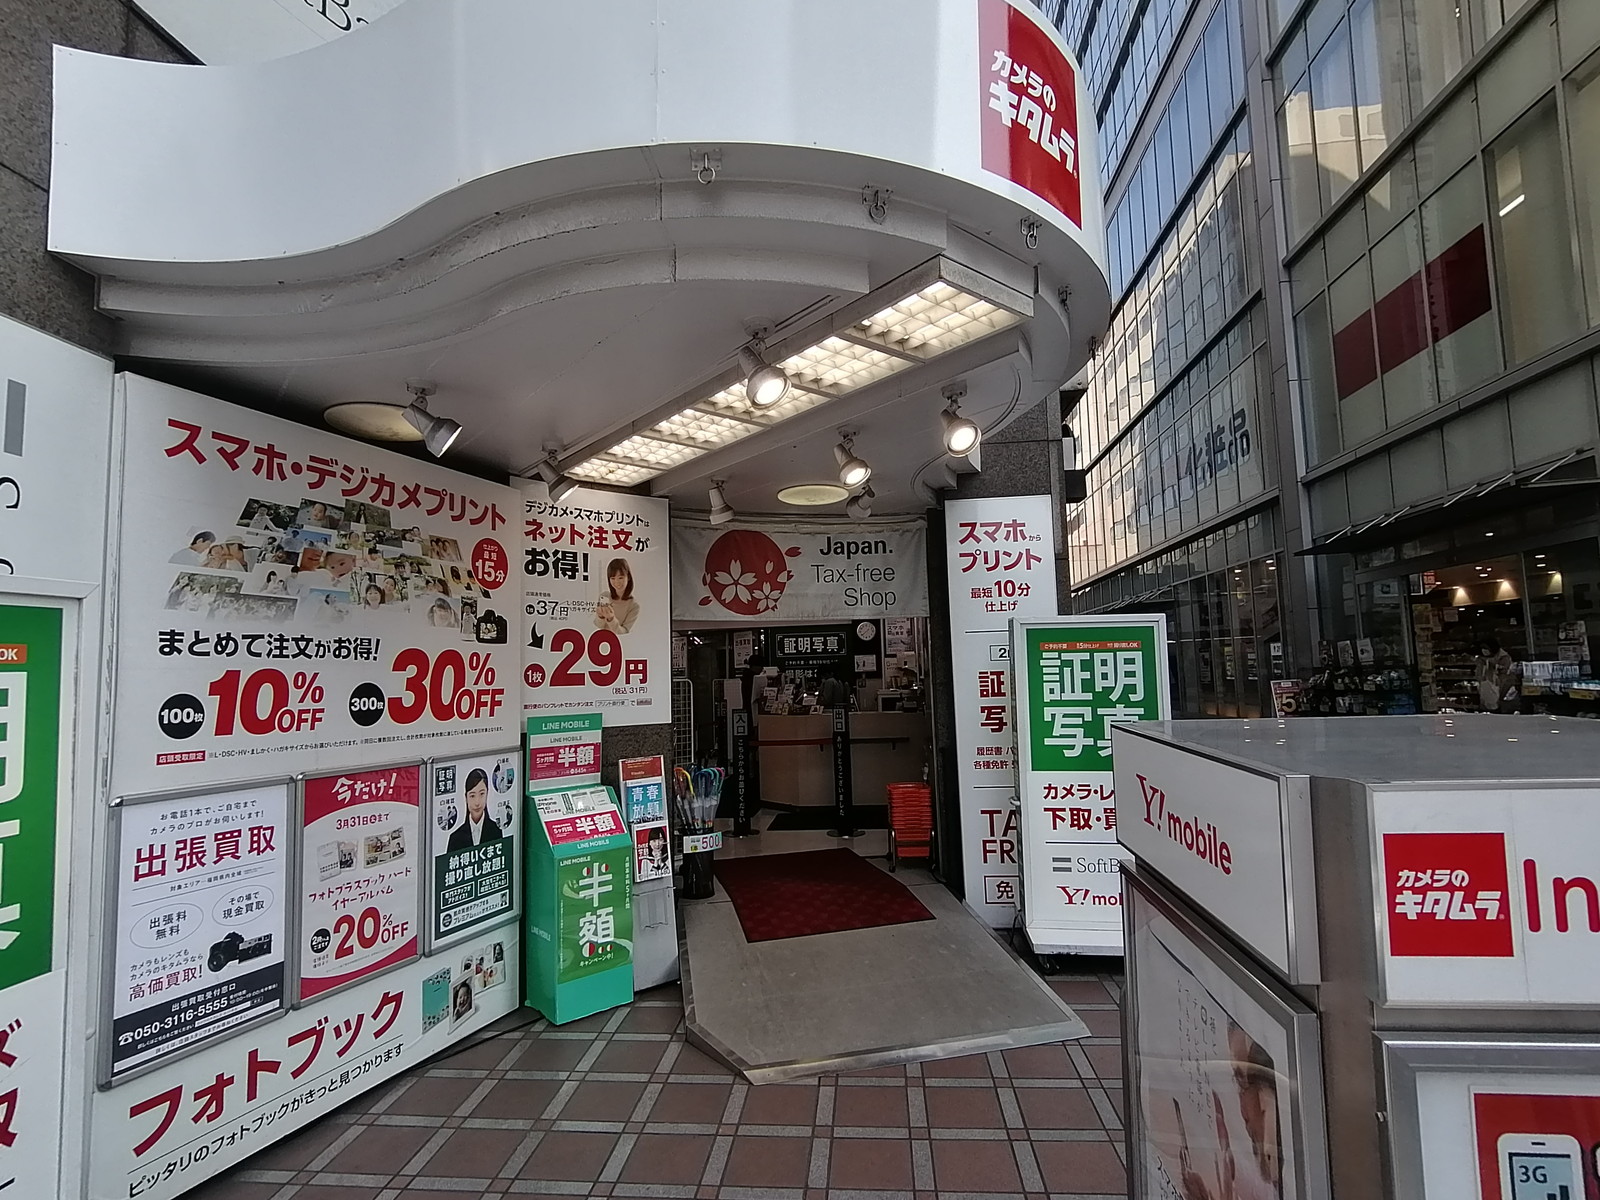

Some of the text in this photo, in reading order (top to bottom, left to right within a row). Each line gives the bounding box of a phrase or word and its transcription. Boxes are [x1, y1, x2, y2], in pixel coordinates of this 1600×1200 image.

[991, 50, 1057, 112] カメラの
[988, 79, 1076, 175] キタムラ
[164, 418, 506, 531] スマホ・デジカメプリント
[524, 499, 650, 528] デジカメ・スマホプリントは
[523, 518, 651, 553] ネット注文が
[958, 519, 1042, 545] スマホから
[818, 535, 894, 560] Japan.
[958, 548, 1043, 573] プリント
[475, 559, 505, 583] 15分
[523, 547, 590, 582] お得!
[810, 562, 896, 584] Tax-free
[843, 587, 897, 610] Shop
[970, 579, 1031, 599] 最短10分
[984, 600, 1019, 613] 仕上げ
[157, 628, 381, 661] まとめて注文がお得!
[526, 669, 543, 683] 1枚
[549, 628, 648, 687] 29円
[783, 636, 840, 654] 証明写真
[350, 647, 497, 725] 300枚 30%
[1040, 651, 1145, 703] 証明
[160, 668, 325, 737] 100枚 10%
[455, 688, 505, 720] OFF
[276, 708, 326, 734] OFF
[542, 720, 590, 730] LINE MOBILE
[735, 713, 747, 735] 入口
[834, 710, 844, 731] 出口
[564, 735, 583, 743] MOBILE
[557, 746, 595, 767] 半額
[331, 772, 398, 804] 今だけ!
[631, 785, 659, 803] 青春
[150, 810, 265, 836] カメラのプロがお伺いします!
[160, 800, 258, 821] お電話1本で、ご自宅まで
[575, 813, 617, 835] 半額
[133, 824, 276, 883] 出張買取
[701, 834, 720, 850] 500
[449, 843, 503, 870] 納得いくまで
[559, 855, 591, 867] LINE MOBILE
[1396, 869, 1470, 888] カメラの
[222, 899, 265, 920] 現金買取
[228, 891, 261, 906] その場で
[331, 885, 394, 911] イヤーアルバム
[578, 862, 615, 945] 半額
[1395, 890, 1502, 920] キタムラ
[149, 909, 187, 930] 出張料
[155, 923, 180, 941] 無料
[381, 920, 409, 944] OFF
[333, 906, 393, 961] 20%
[130, 948, 190, 972] カメラもレンズも
[130, 953, 204, 982] カメラのキタムラなら
[128, 964, 204, 1002] 高価買取!
[171, 982, 237, 1012] 出張買取受付窓口
[133, 996, 228, 1042] 050-3116-5555
[128, 989, 405, 1159] フォトブック
[128, 1041, 405, 1199] ピッタリのフォトブックがきっと見つかります
[1518, 1165, 1548, 1184] 3G
